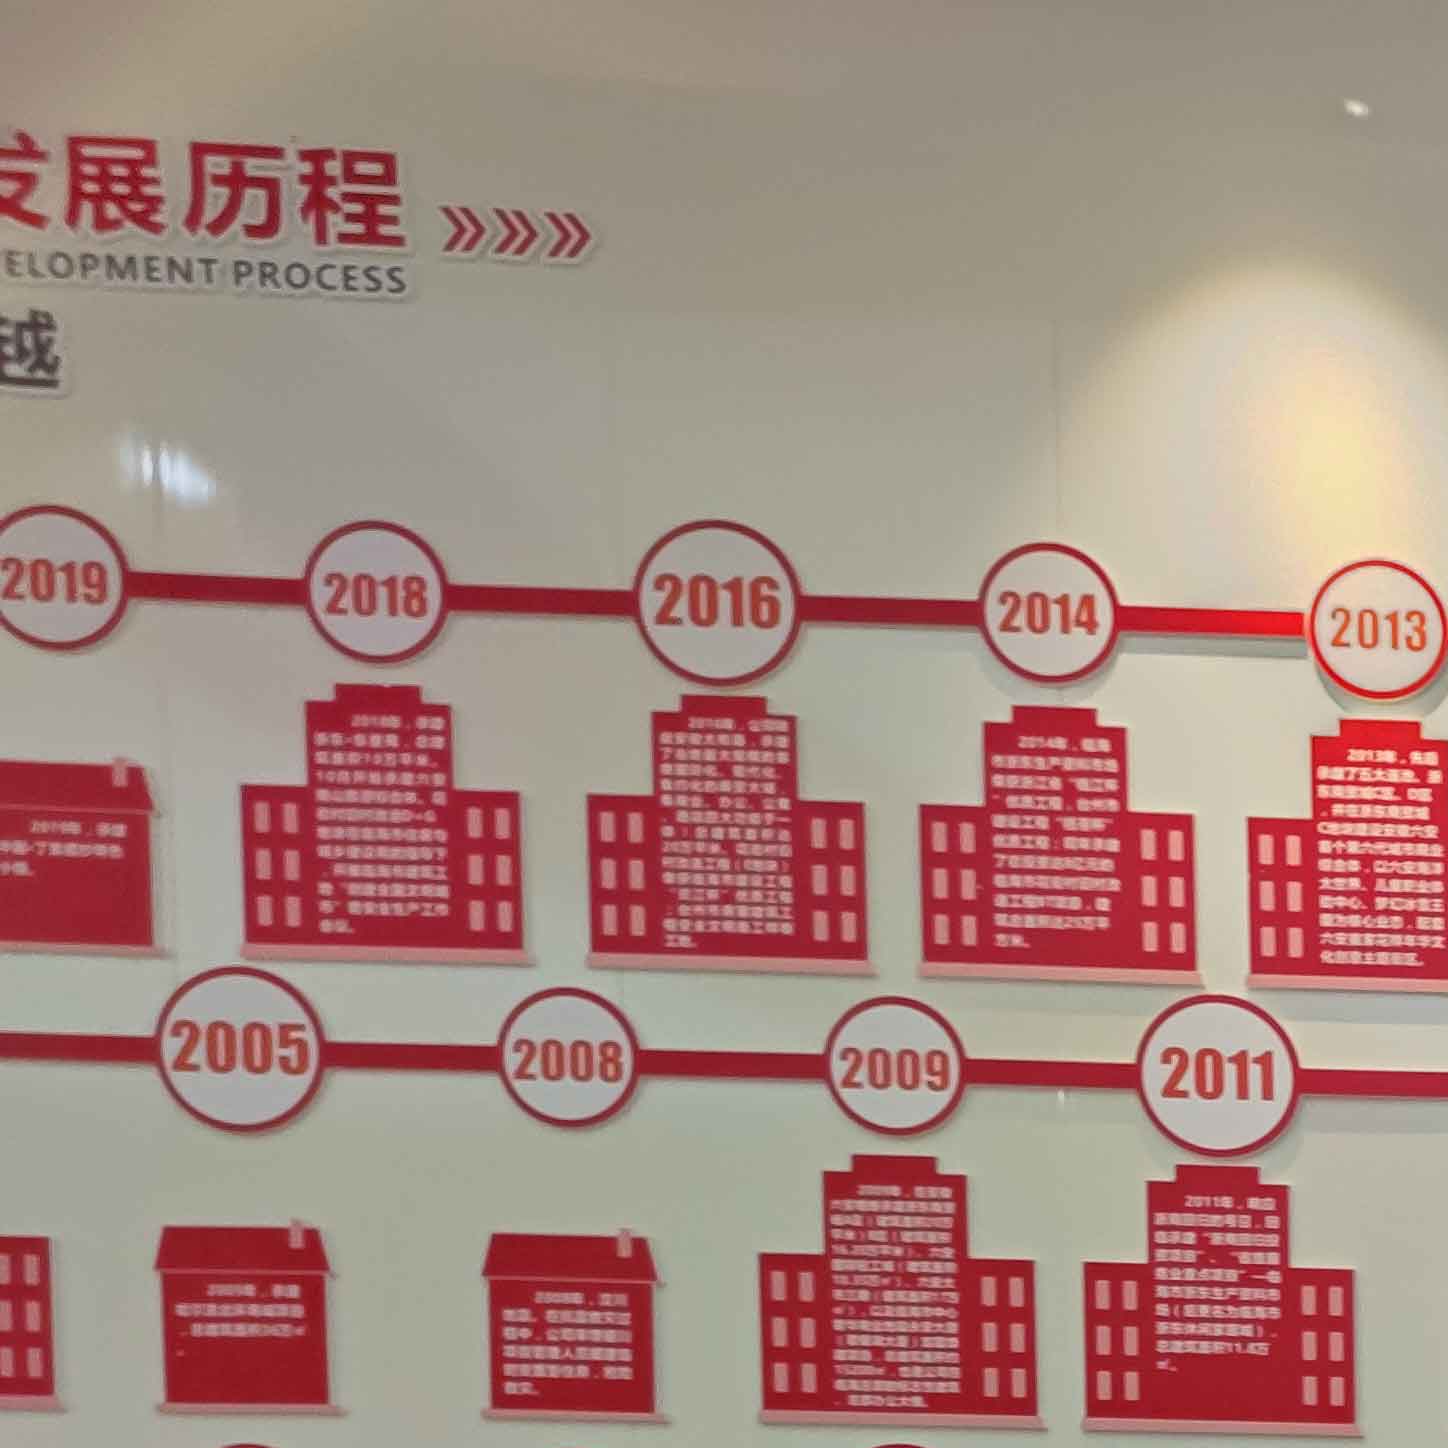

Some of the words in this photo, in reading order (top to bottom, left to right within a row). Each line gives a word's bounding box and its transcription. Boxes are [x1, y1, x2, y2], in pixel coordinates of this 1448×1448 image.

[0, 133, 407, 248] 发展历程
[233, 259, 407, 294] PROCESS
[0, 557, 108, 605] 2019
[323, 572, 429, 618] 2018
[653, 573, 782, 630] 2016
[997, 591, 1100, 636] 2014
[1329, 607, 1428, 653] 2013
[170, 1019, 311, 1076] 2005
[512, 1039, 625, 1084] 2008
[839, 1047, 950, 1092] 2009
[1159, 1046, 1276, 1101] 2011
